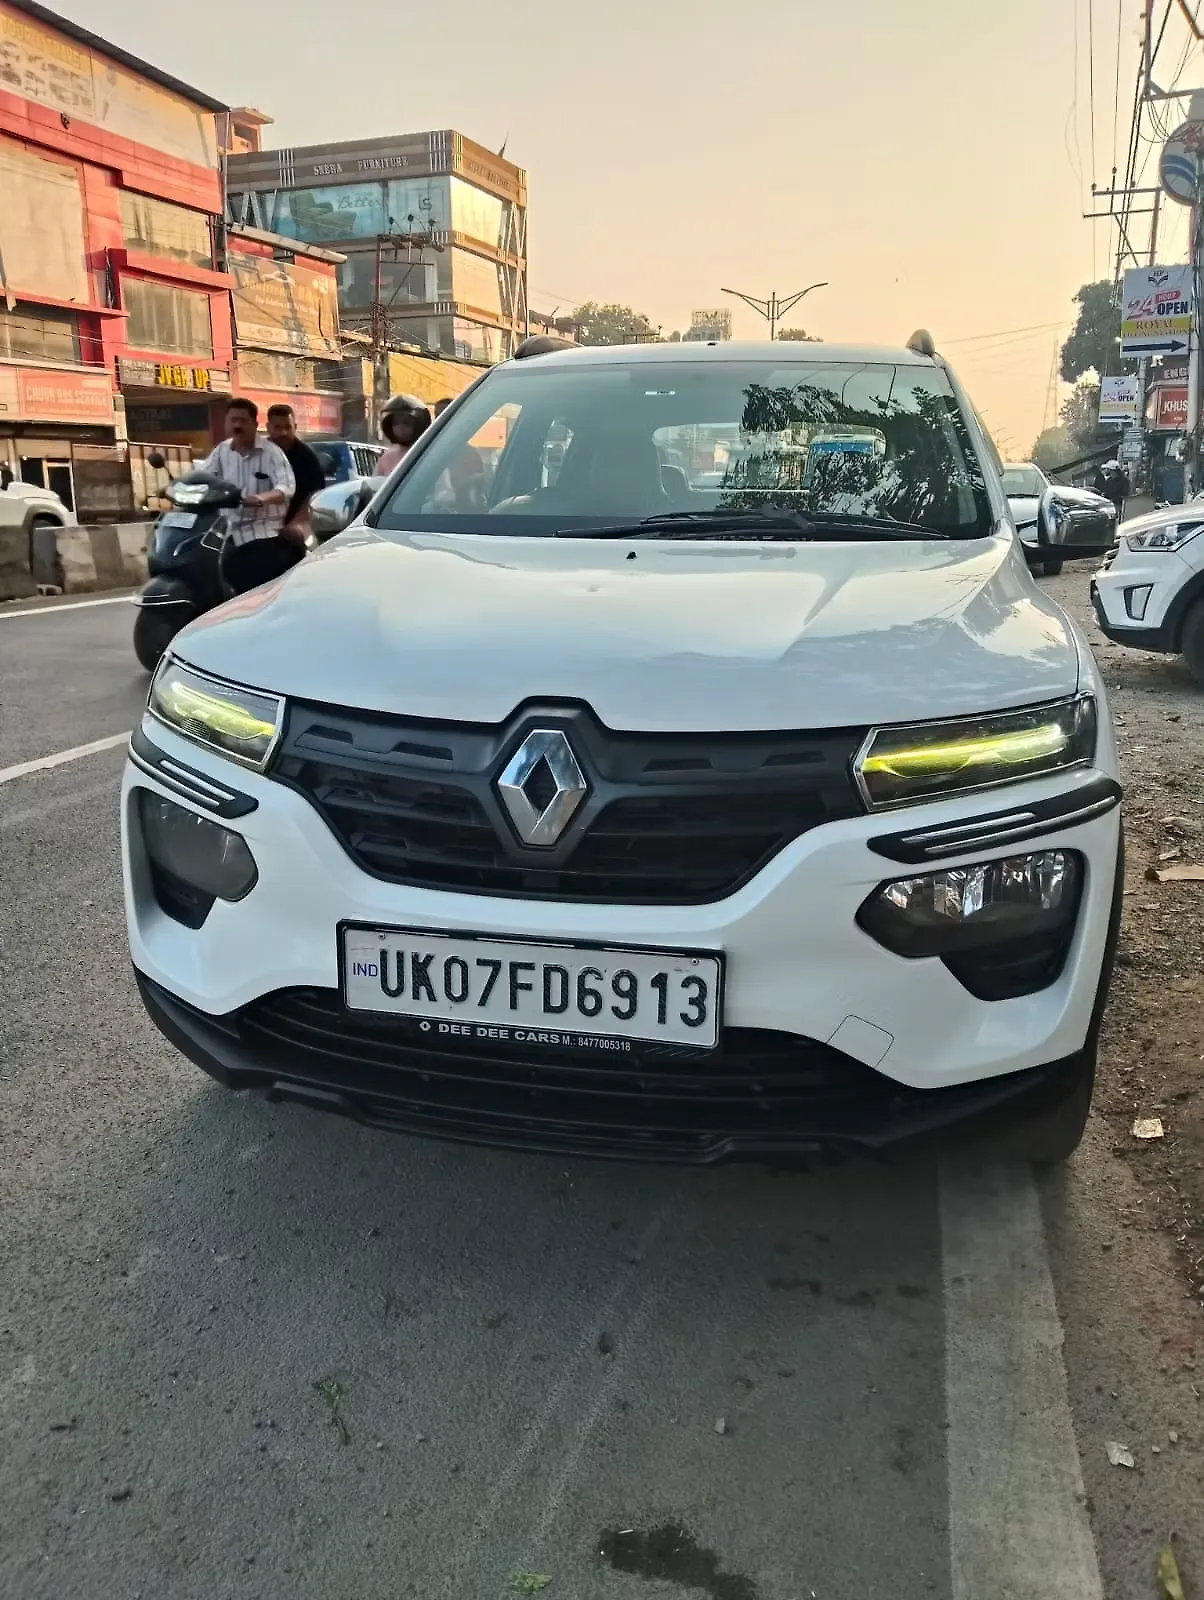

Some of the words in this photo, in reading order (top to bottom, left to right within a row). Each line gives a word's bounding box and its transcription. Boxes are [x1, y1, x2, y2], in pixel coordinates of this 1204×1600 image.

[357, 156, 409, 171] FURNITURE
[1127, 295, 1155, 320] 24
[1157, 301, 1188, 315] OPEN
[352, 962, 378, 977] IND
[379, 949, 708, 1028] UK07FD6913
[438, 1023, 471, 1035] DEE
[476, 1027, 509, 1039] DEE
[514, 1031, 560, 1044] CARS
[578, 1037, 631, 1052] 8477005318
